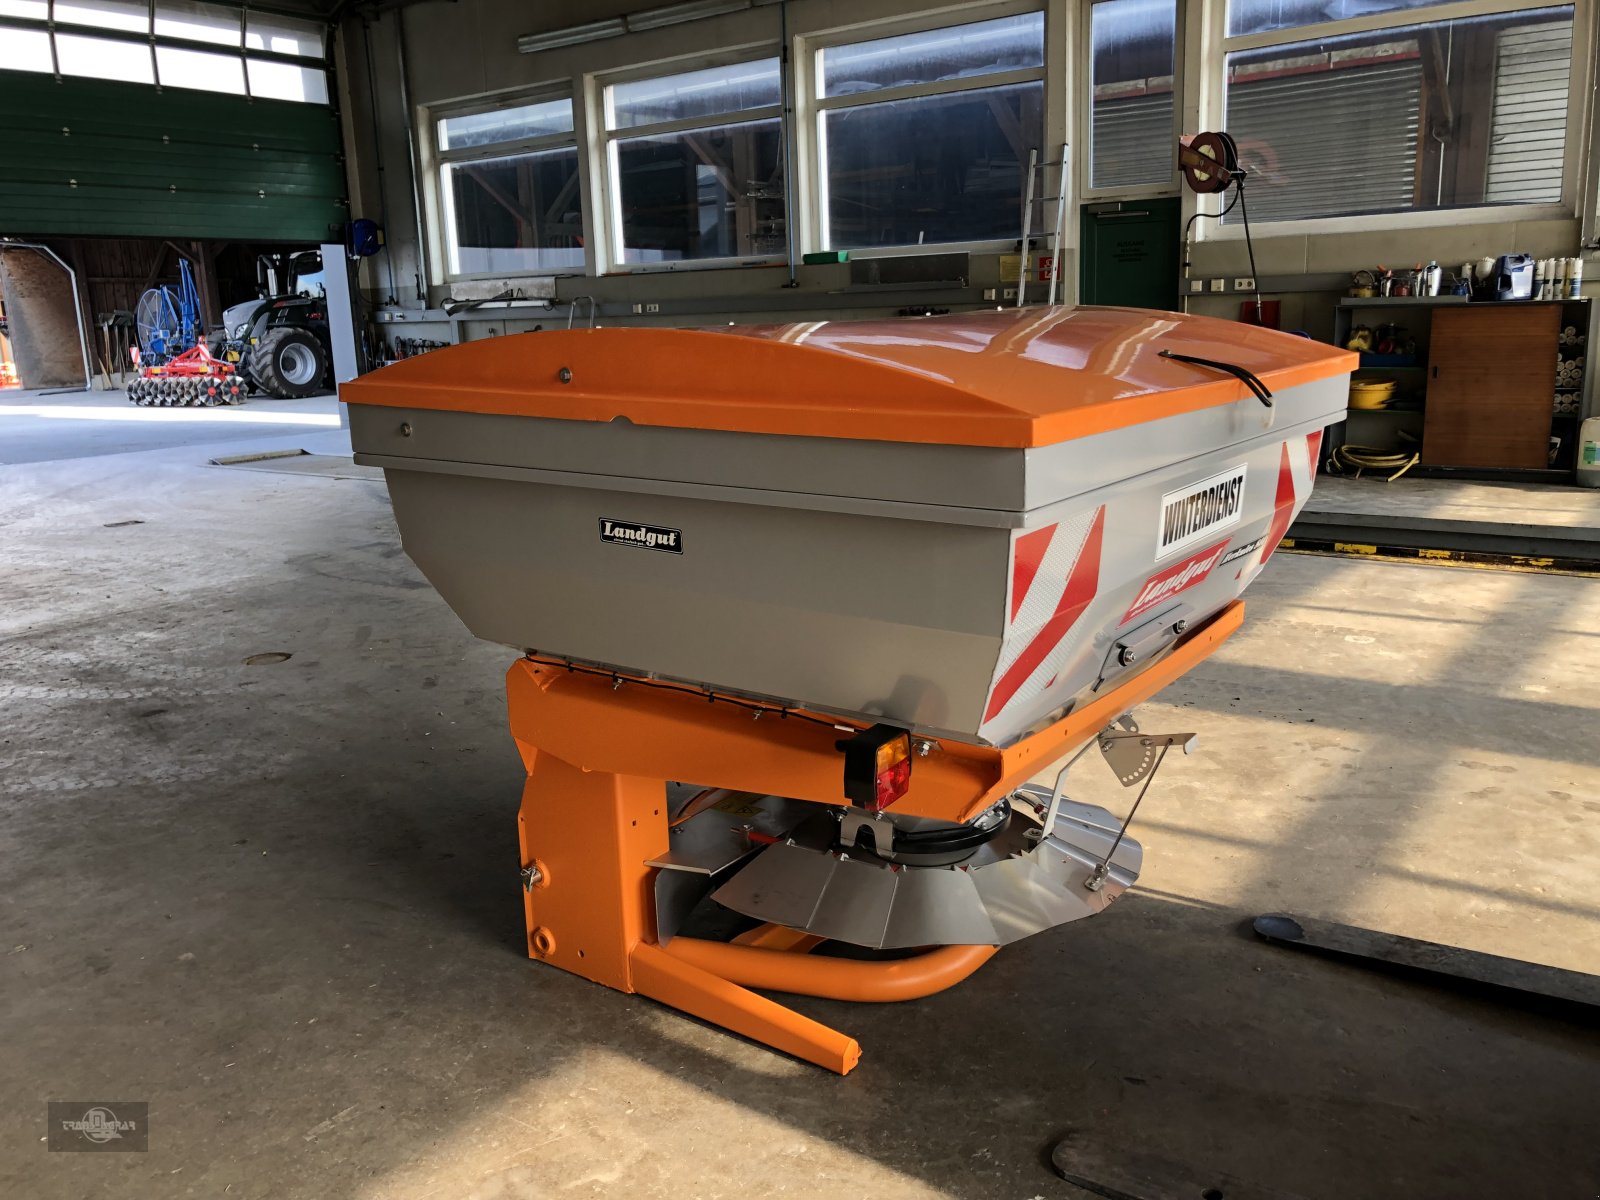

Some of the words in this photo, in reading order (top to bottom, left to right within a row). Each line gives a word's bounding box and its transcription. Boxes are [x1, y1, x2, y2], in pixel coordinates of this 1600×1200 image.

[603, 521, 677, 546] Landgut
[1162, 474, 1244, 547] WINTERDIENST
[1128, 547, 1224, 612] Landgut
